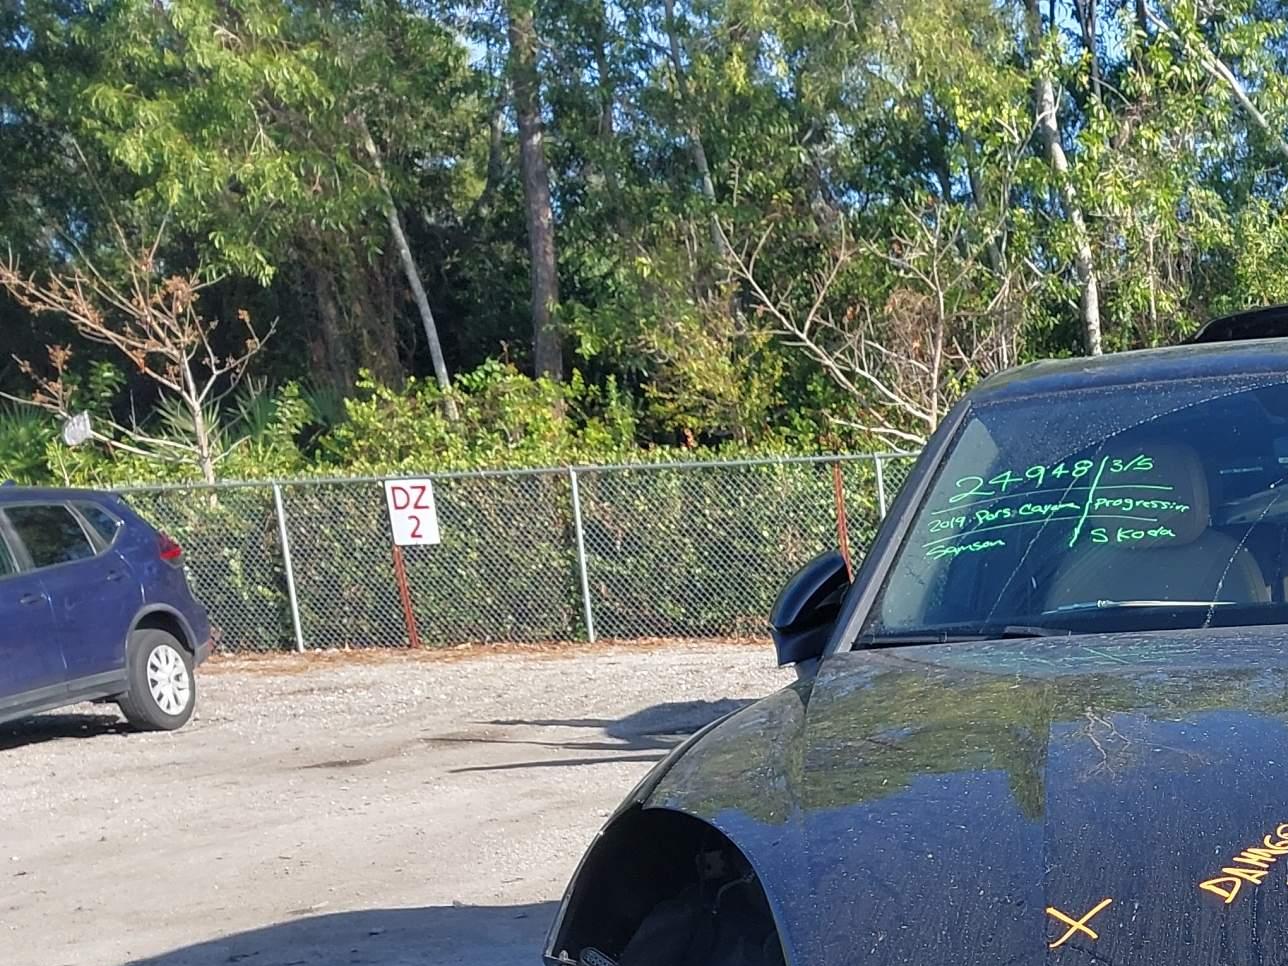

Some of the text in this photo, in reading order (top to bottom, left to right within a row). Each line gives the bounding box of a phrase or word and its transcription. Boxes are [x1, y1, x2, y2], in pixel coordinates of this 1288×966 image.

[949, 454, 1154, 503] 24948 3/5
[390, 485, 430, 510] DZ
[407, 515, 423, 538] 2
[927, 516, 967, 533] 2019
